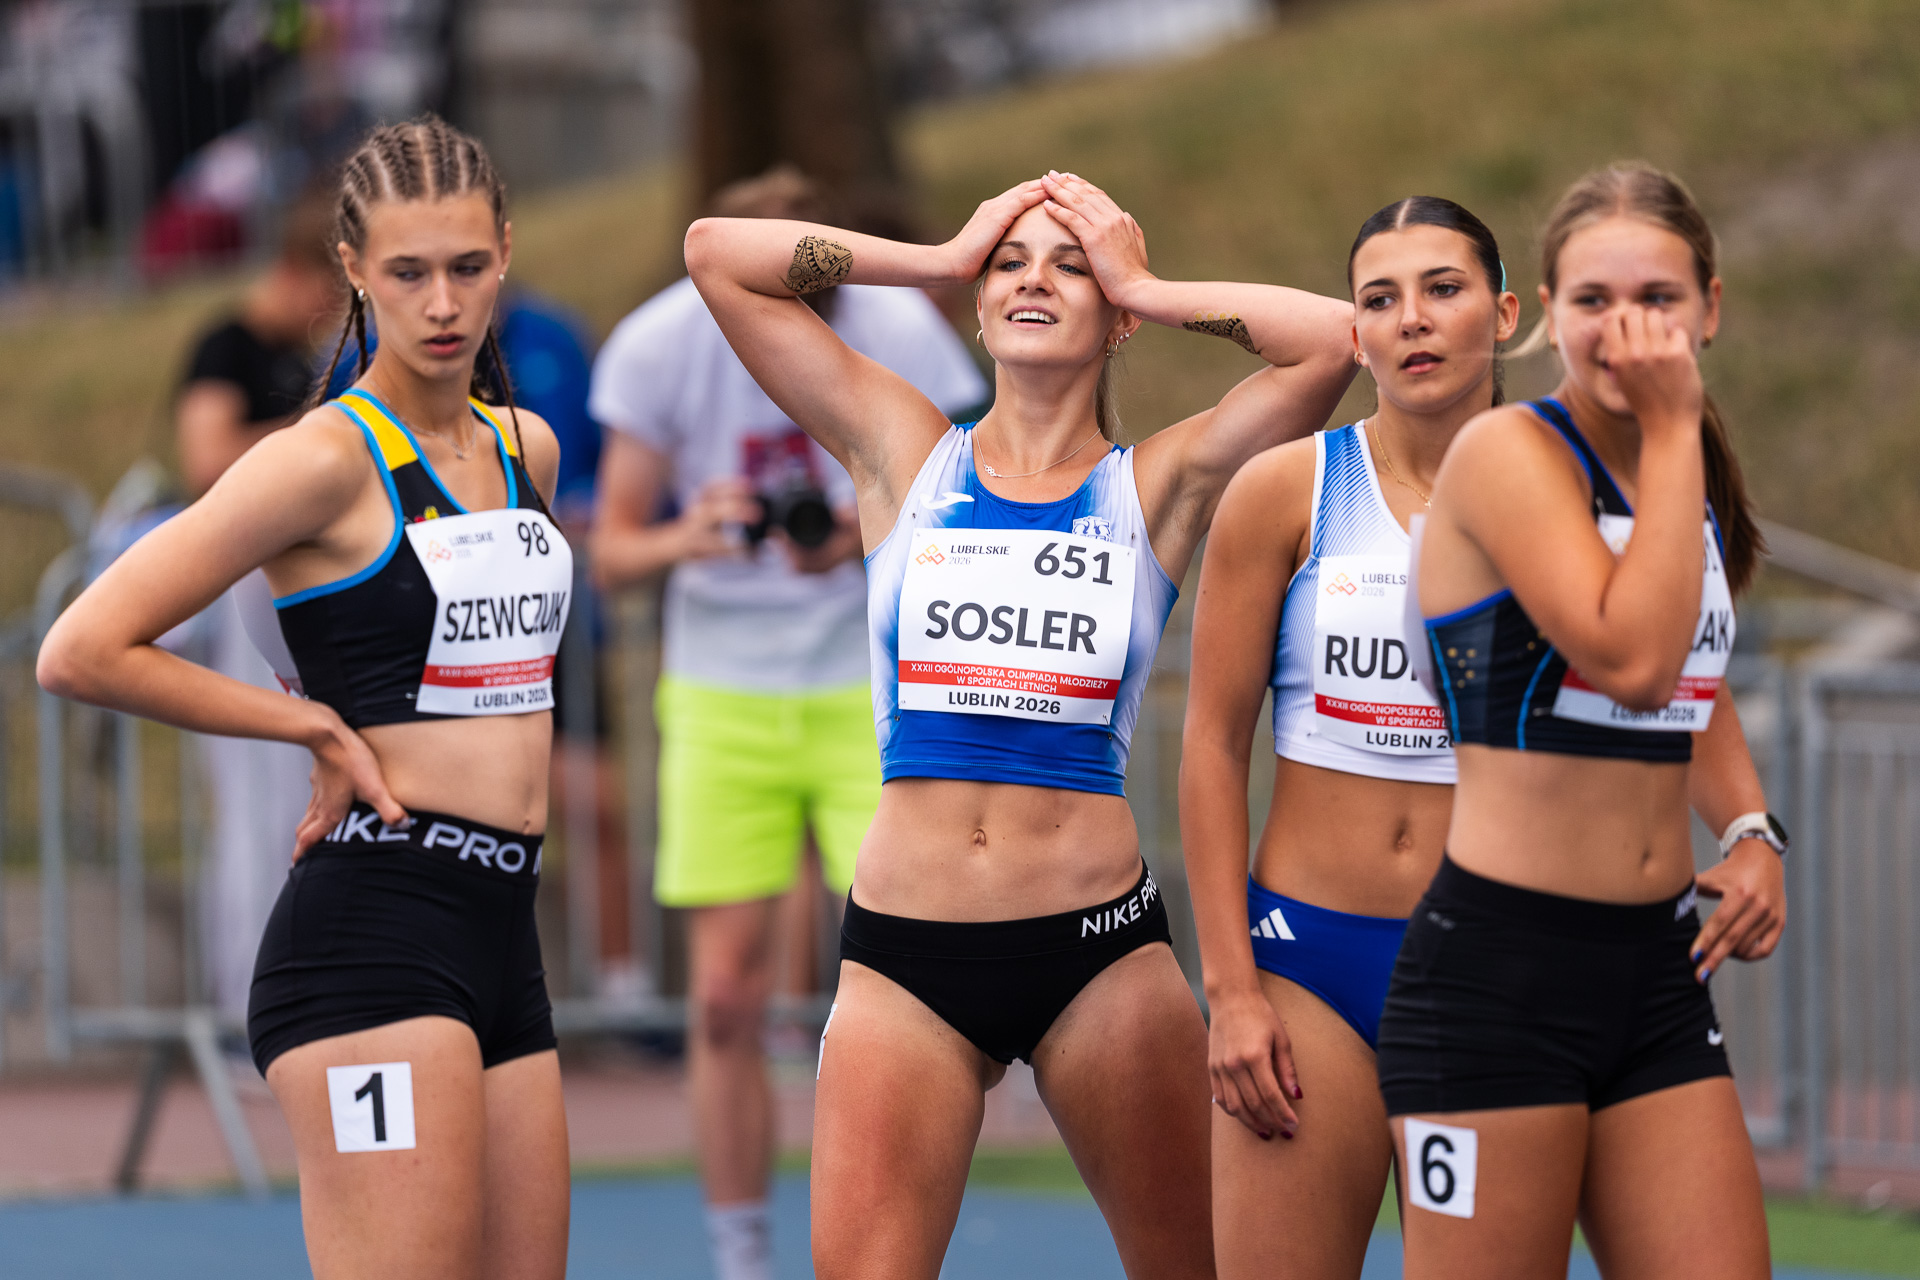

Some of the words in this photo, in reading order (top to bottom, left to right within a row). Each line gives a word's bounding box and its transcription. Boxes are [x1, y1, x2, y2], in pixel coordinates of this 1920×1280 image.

[518, 522, 549, 556] 98
[950, 545, 1010, 555] LUBELSKIE
[949, 557, 971, 565] 2026
[1034, 543, 1113, 585] 651
[1361, 586, 1385, 596] 2026
[443, 591, 566, 644] SZEWCZUK
[925, 600, 1097, 655] SOSLER
[1692, 609, 1729, 652] AK
[1325, 634, 1418, 682] RUD
[911, 663, 933, 673] XXXII
[934, 663, 1005, 678] OGÓLNOPOLSKA
[1007, 669, 1057, 684] OLIMPIADA
[1059, 676, 1109, 689] MŁODZIEŻY
[956, 675, 966, 684] W
[967, 676, 1017, 689] SPORTACH
[1019, 681, 1057, 693] LETNICH
[474, 690, 524, 708] LUBLIN
[948, 691, 1010, 709] LUBLIN
[1014, 696, 1061, 714] 2026
[1375, 715, 1387, 725] W
[1388, 717, 1439, 728] SPORTACH
[1366, 731, 1433, 749] LUBLIN
[422, 821, 526, 873] PRO
[1081, 896, 1141, 938] NIKE
[355, 1072, 387, 1142] 1
[1421, 1134, 1455, 1204] 6
